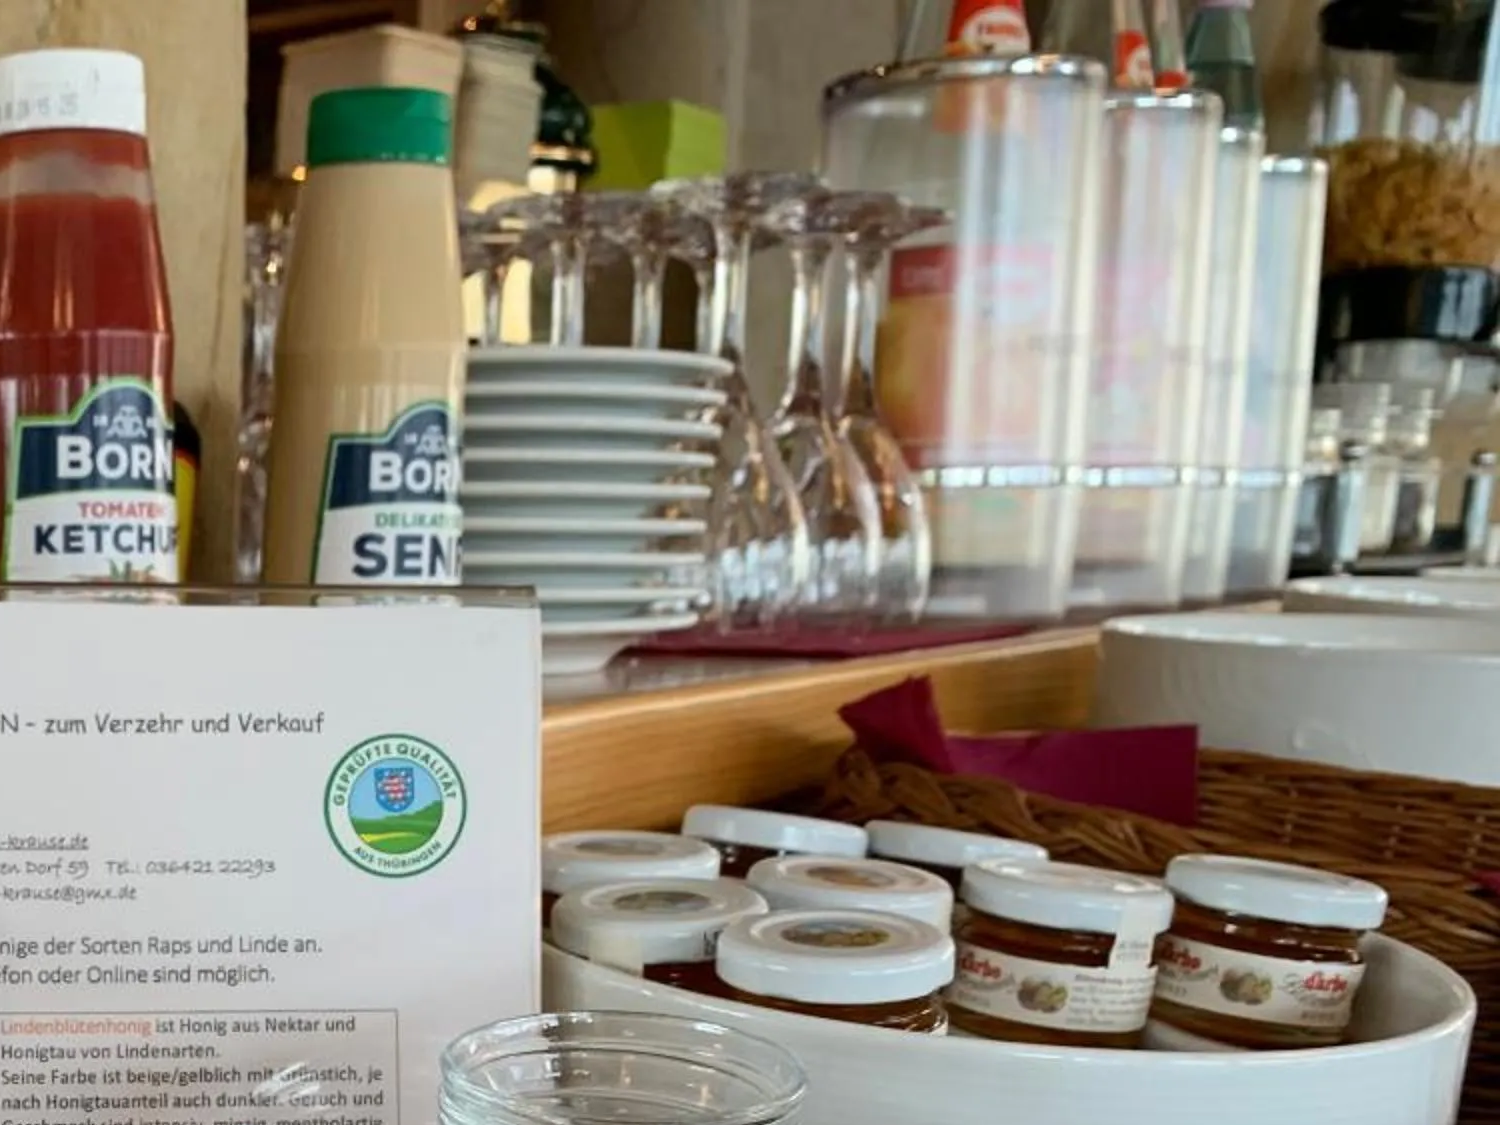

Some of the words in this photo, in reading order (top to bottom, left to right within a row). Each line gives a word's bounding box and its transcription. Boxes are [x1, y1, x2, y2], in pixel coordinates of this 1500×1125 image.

[56, 435, 174, 480] BORN
[44, 718, 87, 735] zum
[94, 712, 184, 735] Verzehr
[190, 712, 231, 734] und
[237, 711, 325, 734] Verkauf
[25, 858, 63, 879] Dorf
[43, 936, 77, 956] der
[80, 935, 143, 956] Sorten
[147, 936, 193, 958] Raps
[197, 935, 234, 955] und
[238, 934, 289, 954] Linde
[293, 938, 323, 954] an.
[37, 965, 82, 985] oder
[86, 964, 149, 985] Online
[152, 964, 192, 984] sind
[196, 963, 275, 988] möglich.
[155, 1019, 176, 1035] ist
[179, 1017, 228, 1038] Honig
[231, 1020, 261, 1034] aus
[264, 1016, 321, 1034] Nektar
[324, 1015, 357, 1033] und
[0, 1044, 77, 1064] Honigtau
[79, 1046, 112, 1060] von
[116, 1042, 221, 1060] Lindenarten.
[0, 1069, 47, 1086] Seine
[50, 1068, 98, 1086] Farbe
[102, 1069, 123, 1086] ist
[125, 1066, 242, 1088] beige/gelblich
[246, 1066, 275, 1083] mit
[366, 1066, 384, 1086] je
[1, 1093, 42, 1111] nach
[45, 1091, 169, 1114] Honigtauanteil
[171, 1091, 212, 1109] auch
[287, 1088, 349, 1110] Geruch
[352, 1089, 384, 1107] und
